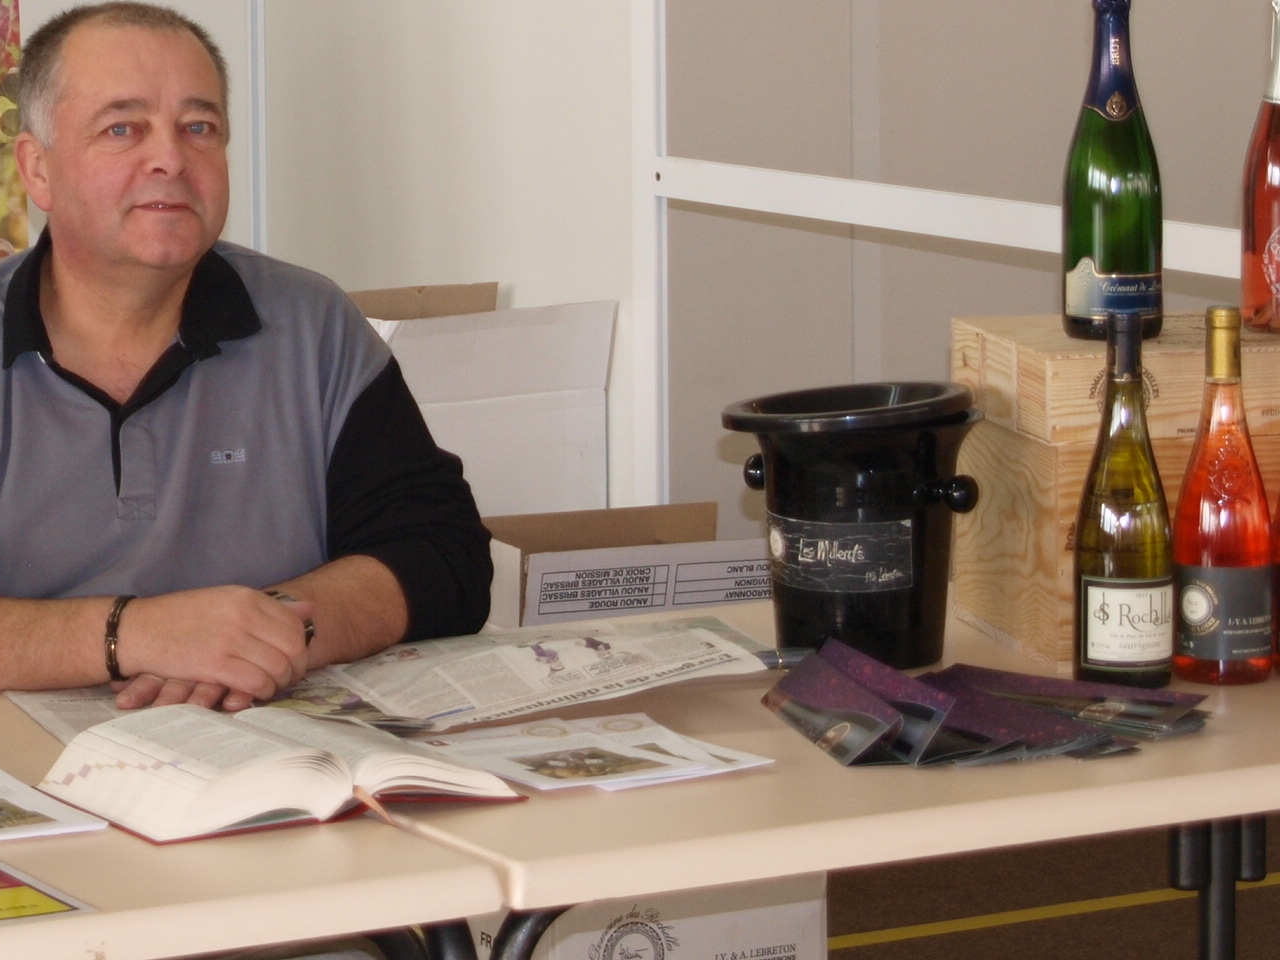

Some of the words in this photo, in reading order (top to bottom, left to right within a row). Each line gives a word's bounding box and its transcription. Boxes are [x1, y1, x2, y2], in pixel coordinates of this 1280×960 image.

[1111, 38, 1119, 65] BRUT
[798, 537, 817, 563] Les
[612, 568, 624, 577] DE
[626, 567, 651, 576] CROIX
[726, 564, 756, 574] BLANC
[575, 570, 611, 580] MISSION
[621, 575, 651, 584] ANJOU
[542, 580, 580, 590] BRISSAC
[581, 577, 620, 587] VILLAGES
[580, 588, 619, 597] VILLAGES
[620, 585, 650, 593] ANJOU
[541, 591, 579, 601] BRISSAC
[589, 599, 619, 609] ROUGE
[620, 597, 649, 606] ANJOU
[624, 674, 651, 686] de
[602, 680, 624, 691] la
[626, 904, 641, 919] des
[750, 942, 797, 958] LEBRETON
